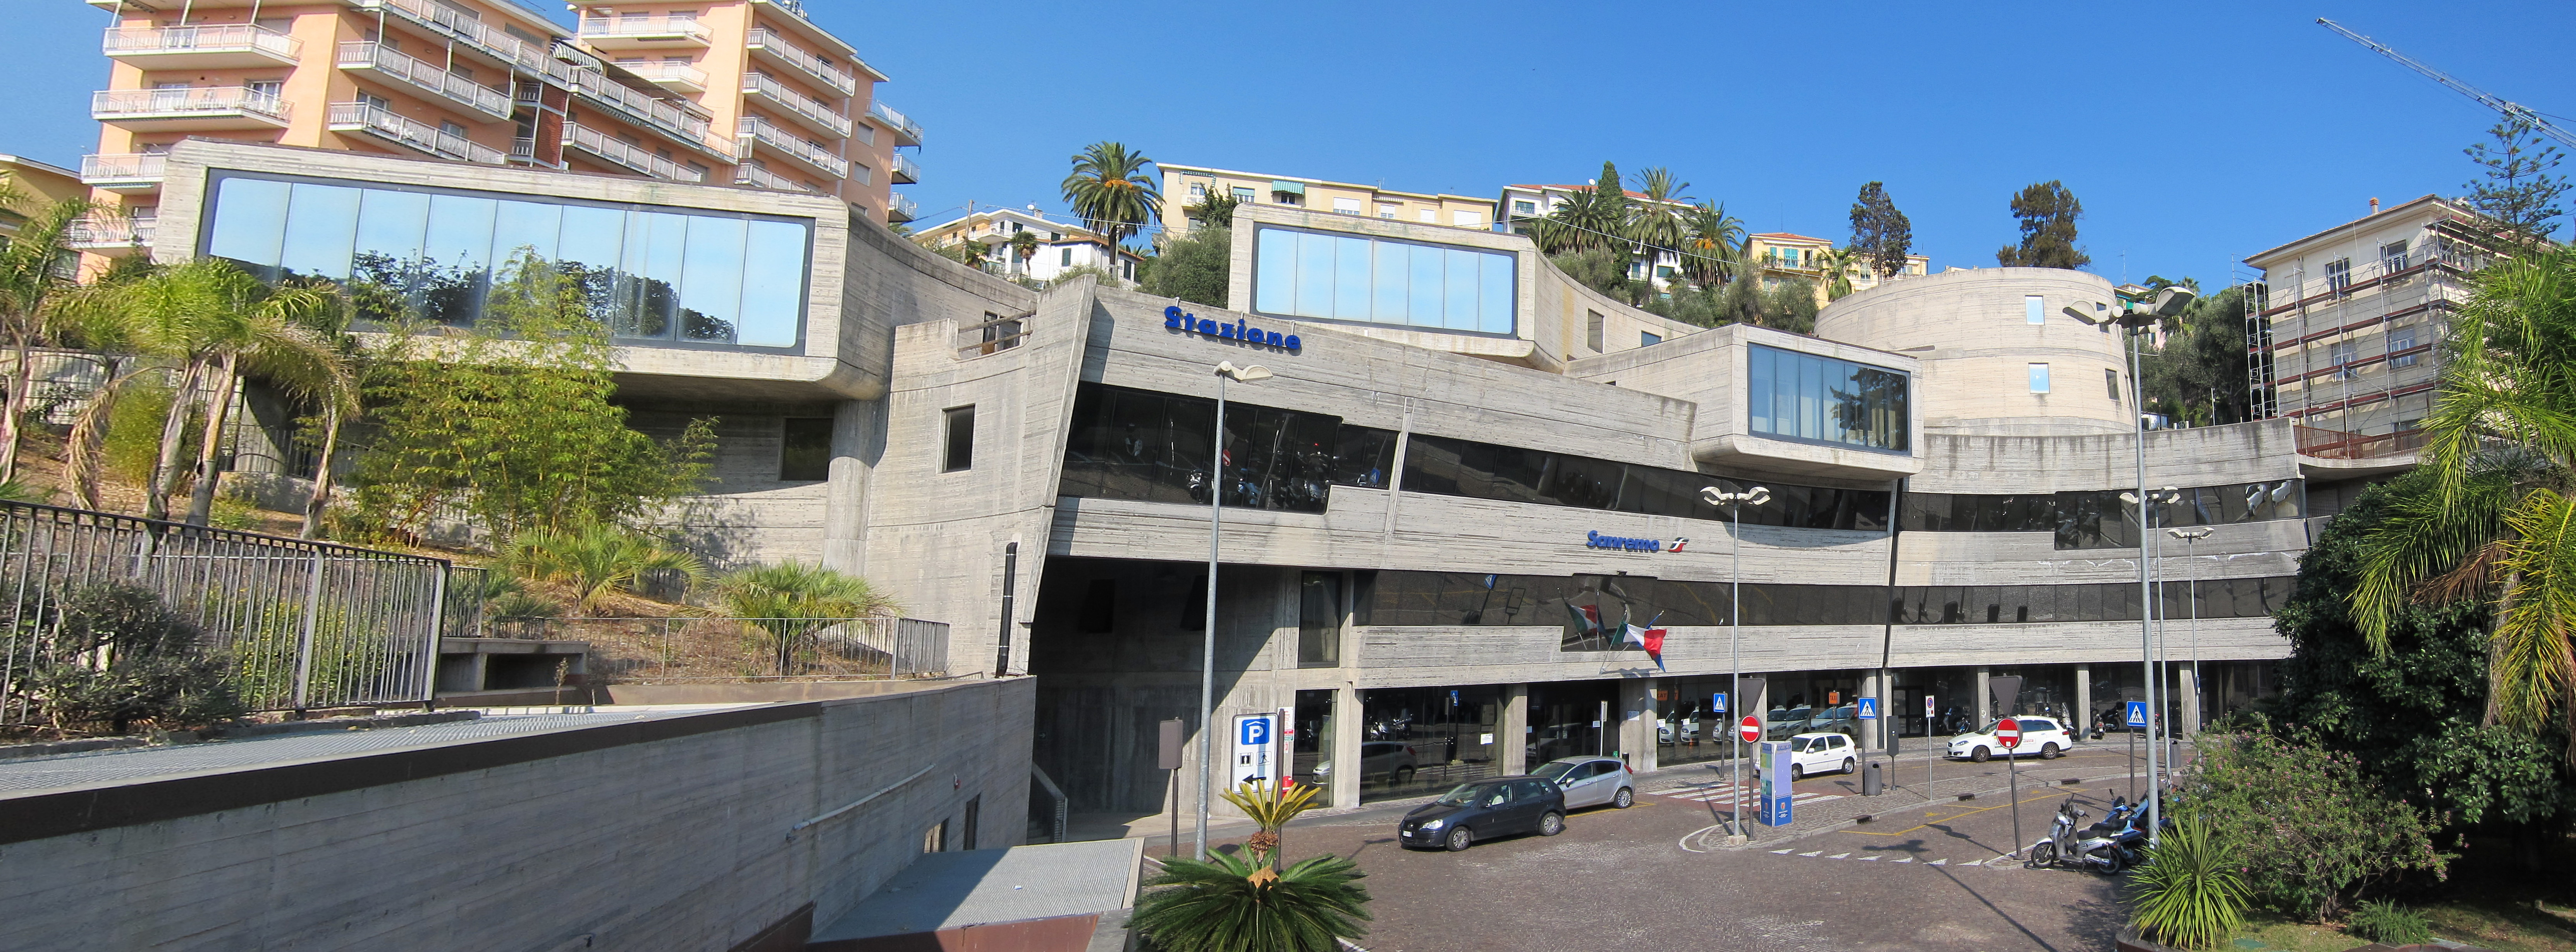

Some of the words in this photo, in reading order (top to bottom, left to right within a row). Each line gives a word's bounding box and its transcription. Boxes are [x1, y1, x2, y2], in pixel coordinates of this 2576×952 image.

[1164, 306, 1301, 349] Stazione
[1586, 530, 1659, 551] Sanremo
[1248, 725, 1264, 743] P
